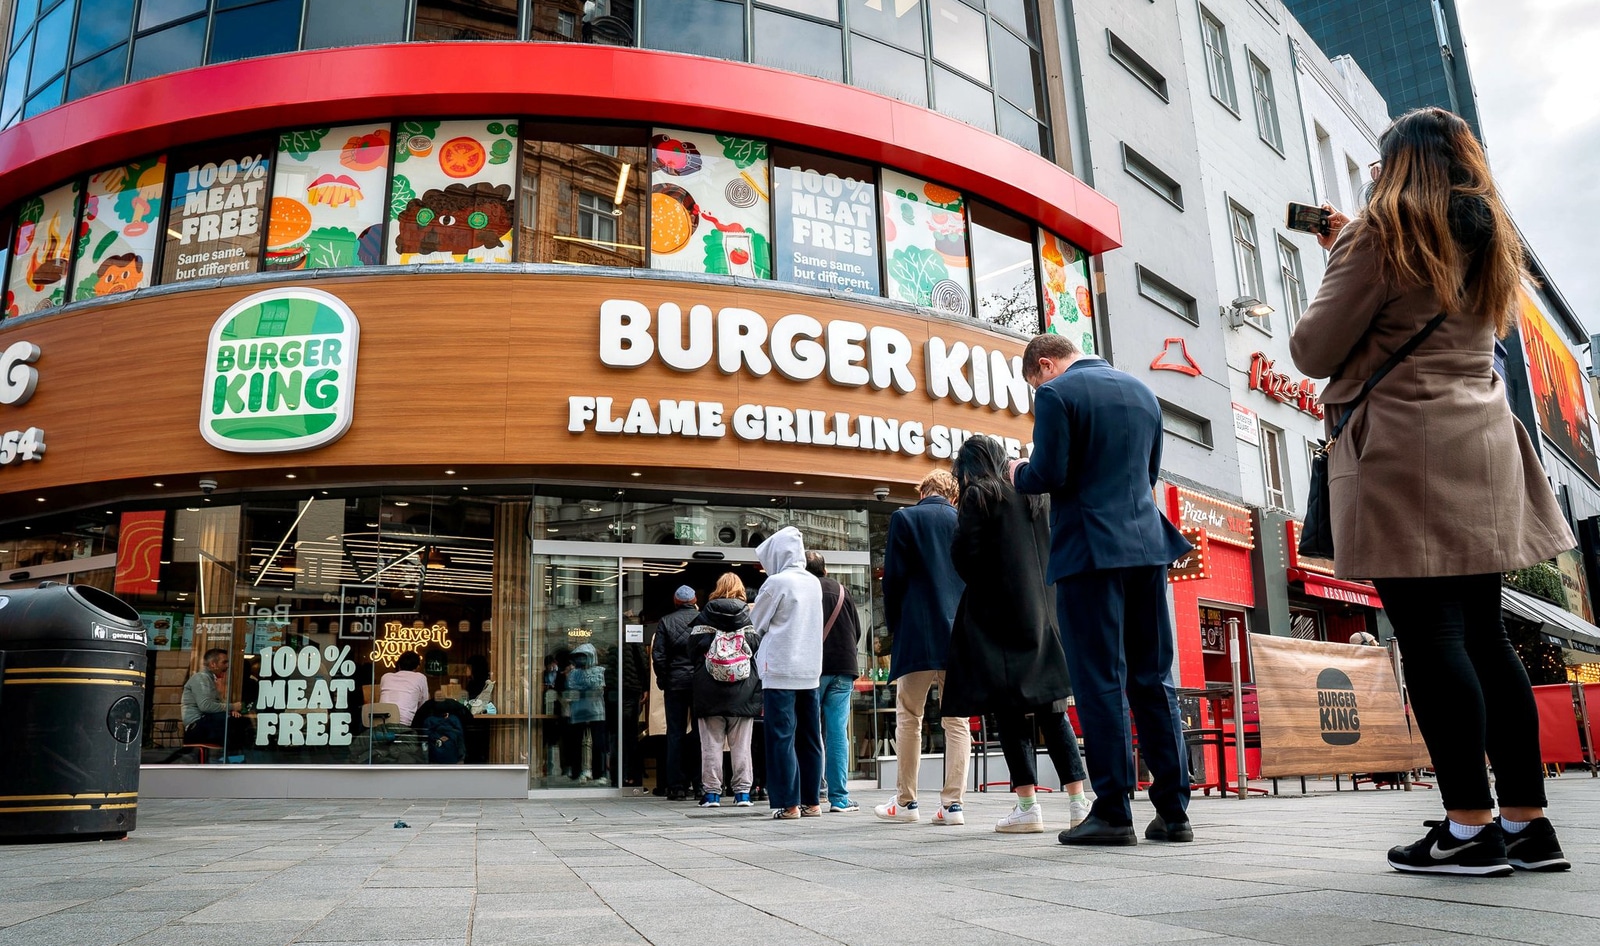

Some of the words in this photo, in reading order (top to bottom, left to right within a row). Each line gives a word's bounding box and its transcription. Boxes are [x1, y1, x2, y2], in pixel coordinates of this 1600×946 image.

[187, 154, 265, 190] 100%
[790, 166, 870, 204] 100%
[183, 180, 263, 216] MEAT
[791, 192, 872, 228] MEAT
[180, 207, 258, 245] FREE
[792, 217, 872, 257] FREE
[176, 267, 196, 280] but
[198, 260, 250, 277] different
[178, 252, 209, 265] Same
[211, 247, 246, 260] same,
[794, 252, 828, 268] Same
[830, 261, 865, 276] same,
[794, 266, 815, 280] but
[818, 271, 874, 291] different.
[216, 338, 342, 372] BURGER
[600, 299, 917, 394] BURGER
[925, 336, 1035, 416] KIN
[212, 368, 339, 415] KING
[1249, 351, 1301, 404] Pizza
[568, 396, 726, 438] FLAME
[731, 404, 925, 457] GRILLING
[926, 424, 1021, 461] SIE
[0, 427, 40, 465] 54
[1182, 500, 1208, 523] Pizza
[1208, 508, 1225, 528] Hut
[1323, 586, 1370, 606] RESTAURANT
[112, 632, 134, 640] general
[370, 640, 428, 661] your
[384, 622, 431, 641] Have
[431, 625, 452, 649] it
[259, 644, 356, 677] 100%
[256, 679, 355, 710] MEAT
[1317, 691, 1357, 707] BURGER
[255, 712, 353, 746] FREE
[1319, 707, 1360, 731] KING
